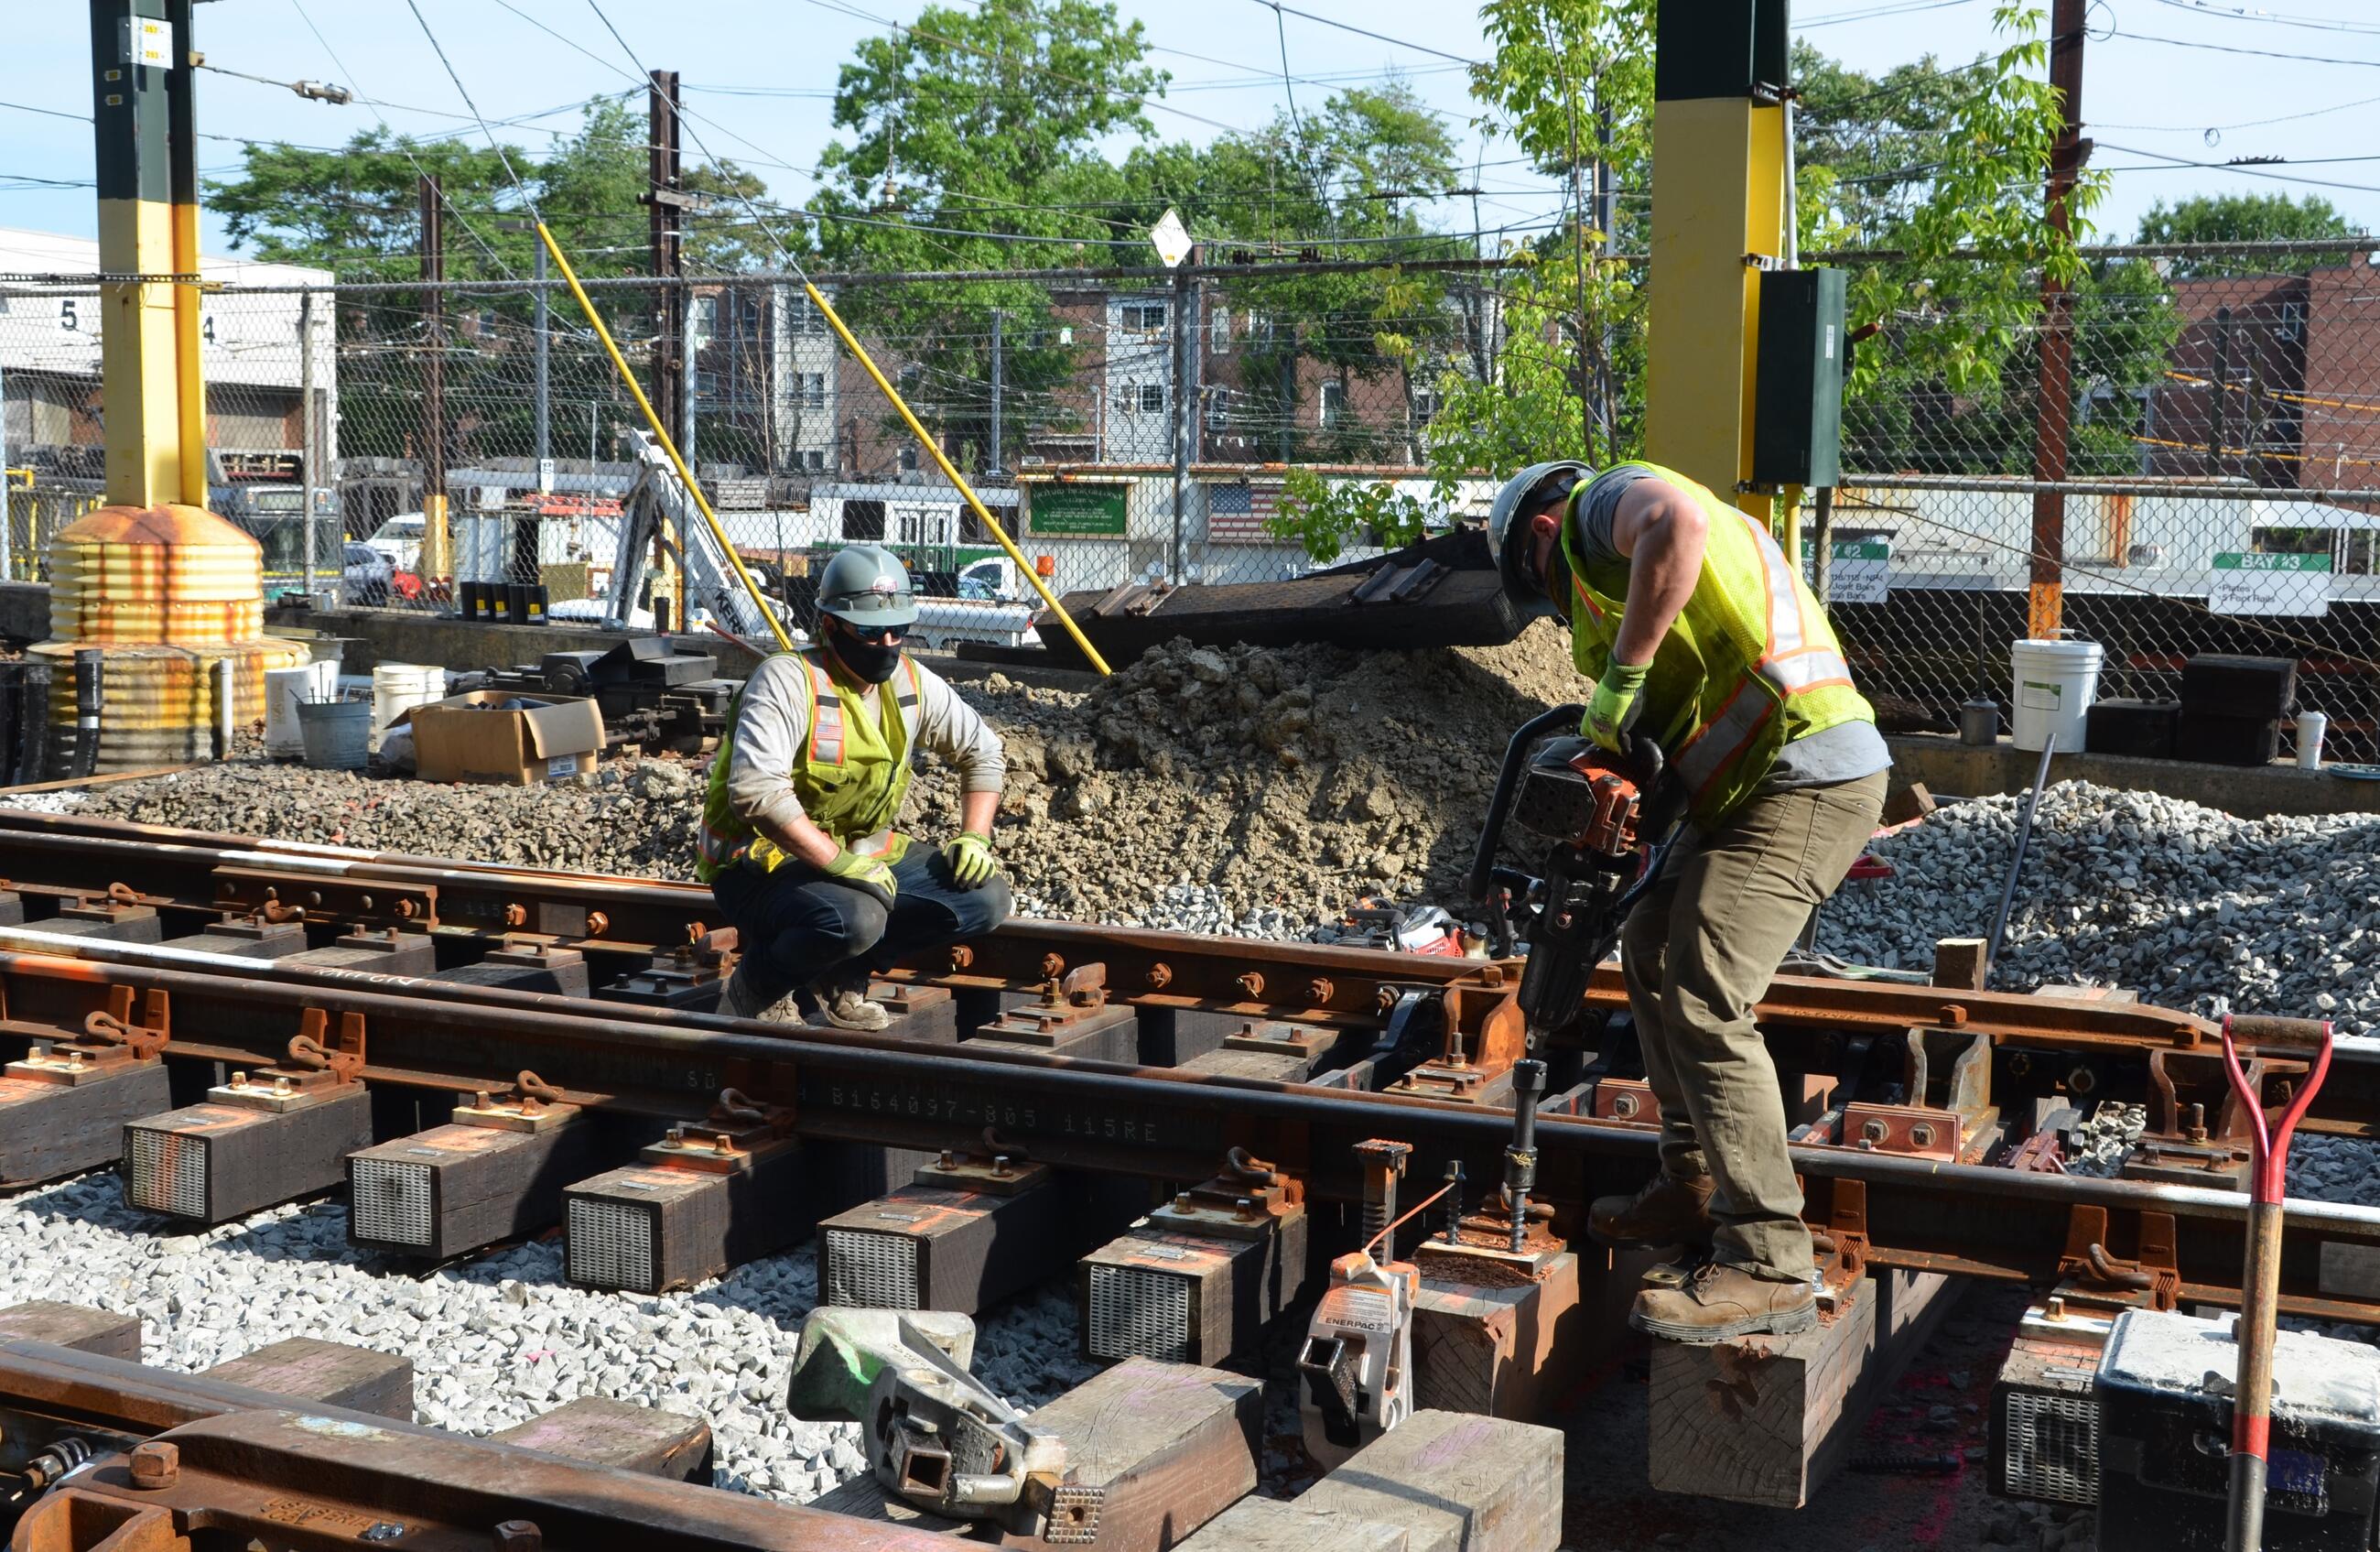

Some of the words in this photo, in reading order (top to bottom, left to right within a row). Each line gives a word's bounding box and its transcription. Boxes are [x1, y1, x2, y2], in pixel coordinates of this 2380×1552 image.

[61, 300, 77, 331] 5
[203, 316, 215, 344] 4
[1844, 544, 1861, 558] #2
[2240, 555, 2277, 569] BAY
[2281, 556, 2300, 569] #3
[1325, 1317, 1375, 1330] ENERPAC
